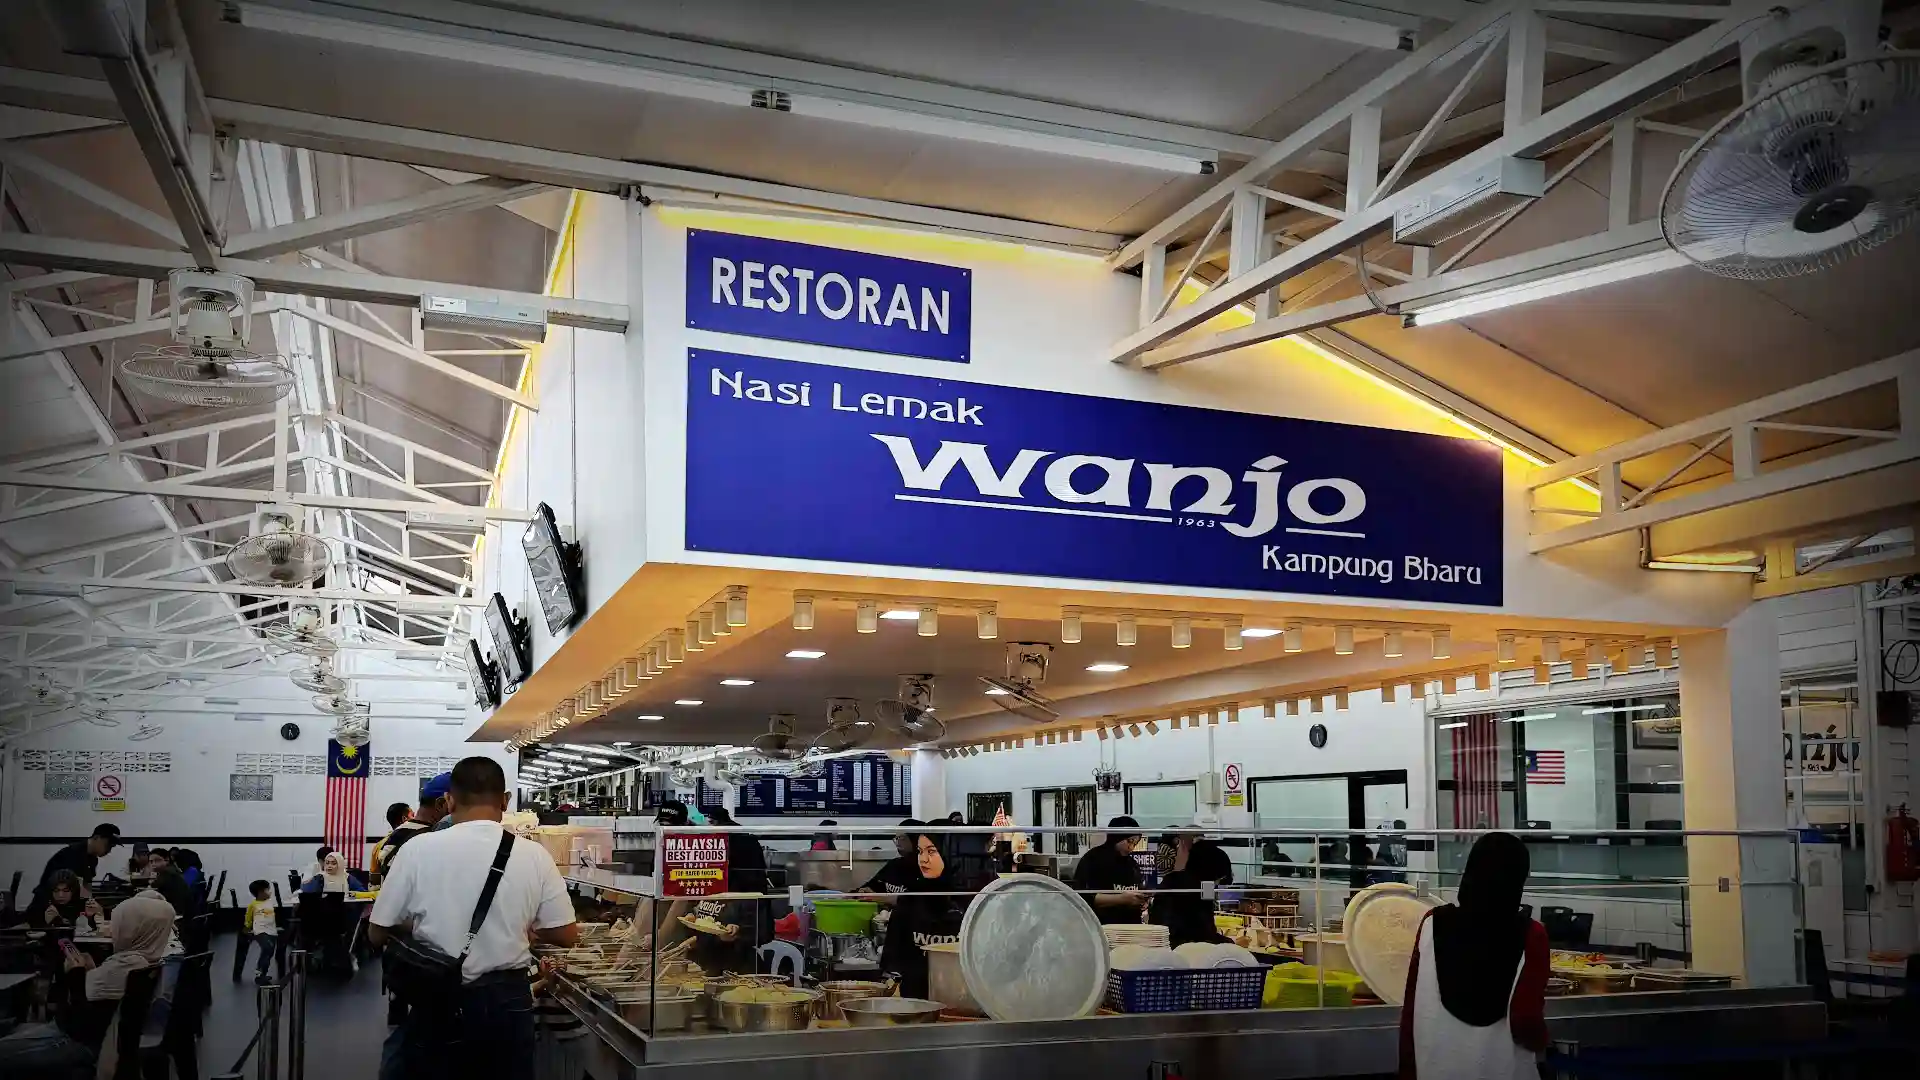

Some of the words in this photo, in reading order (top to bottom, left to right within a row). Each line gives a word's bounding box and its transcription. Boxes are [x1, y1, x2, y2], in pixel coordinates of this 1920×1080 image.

[712, 257, 950, 335] RESTORAN
[711, 368, 811, 407] Nasi
[832, 382, 984, 426] Lemak
[869, 433, 1366, 538] wanjo
[1177, 517, 1215, 528] 1963
[1262, 544, 1393, 584] Kampung
[1404, 555, 1482, 585] Bharu
[665, 838, 726, 850] MALAYSIA
[667, 850, 692, 861] BEST
[693, 850, 724, 861] FOODS
[1131, 854, 1155, 866] SHIER
